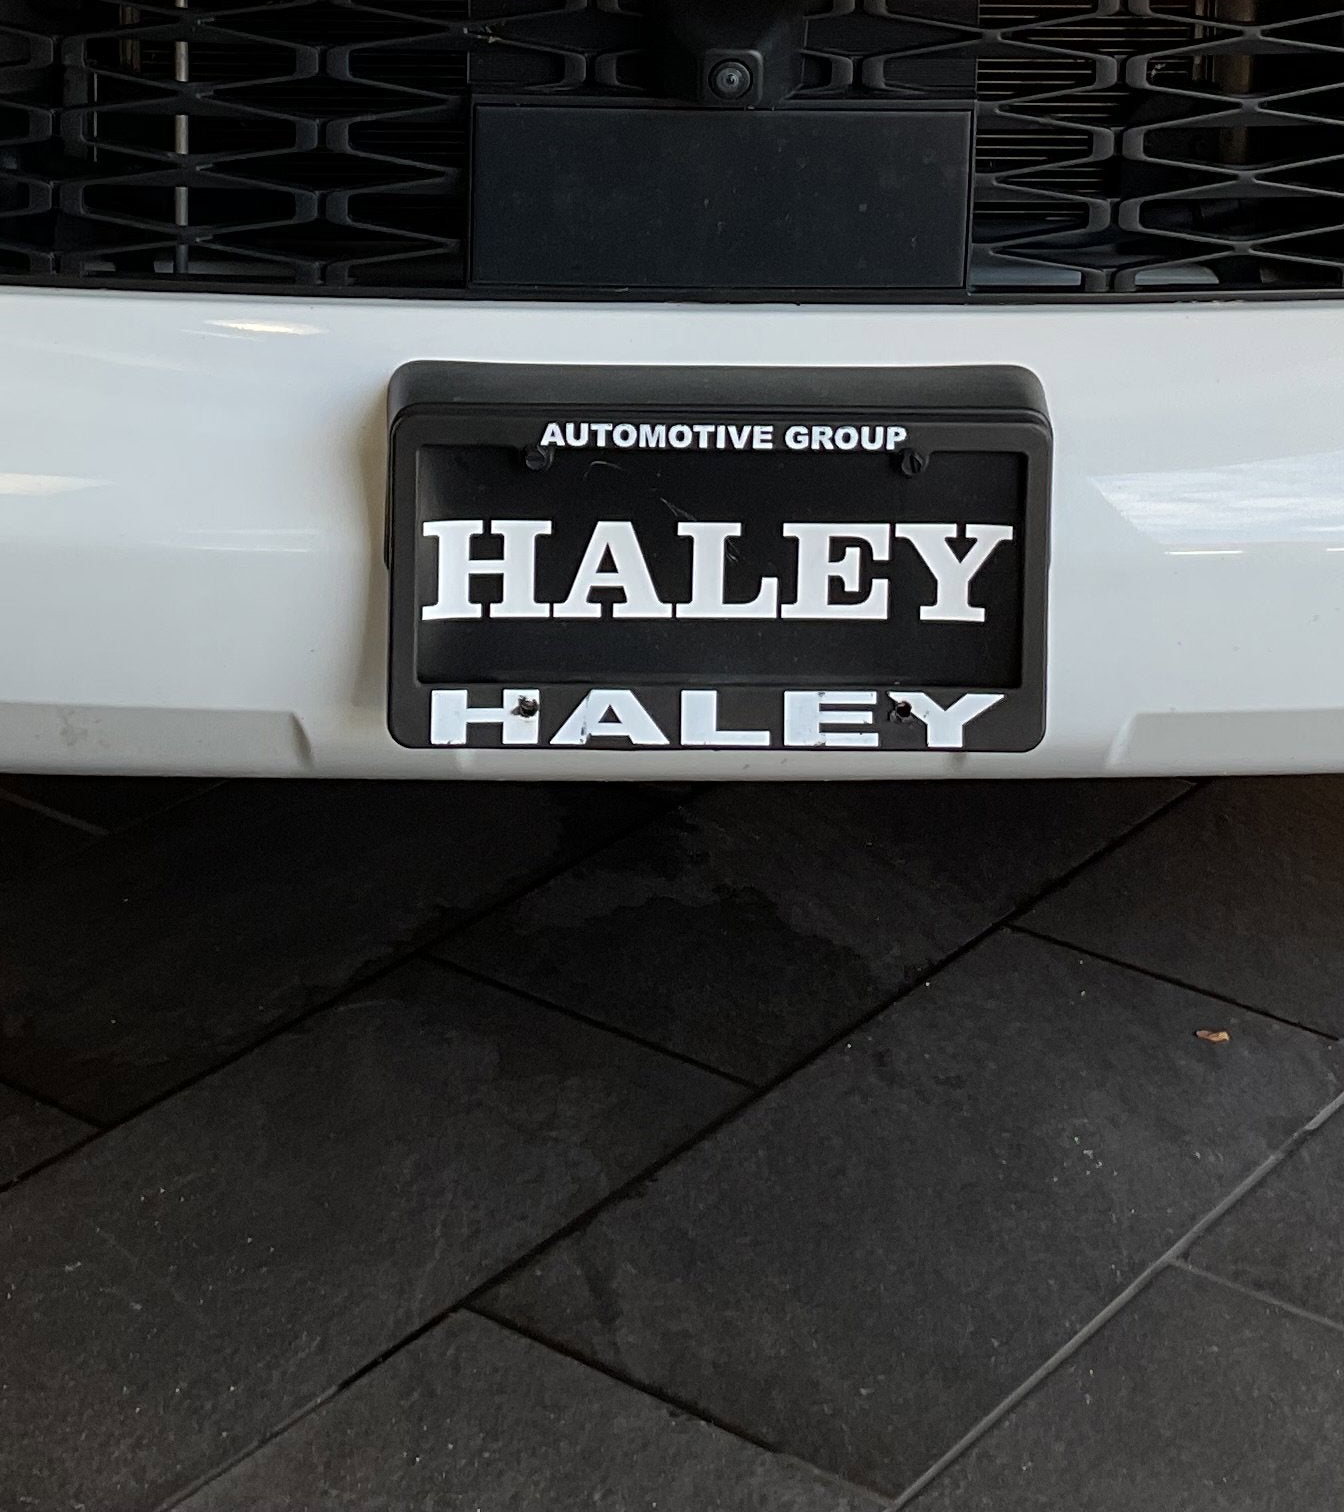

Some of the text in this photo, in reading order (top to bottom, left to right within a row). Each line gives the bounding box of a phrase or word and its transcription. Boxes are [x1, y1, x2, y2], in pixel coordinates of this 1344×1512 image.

[540, 422, 908, 451] AUTOMOTIVE GROUP
[421, 519, 1014, 622] HALEY
[430, 688, 1005, 748] HALEY
